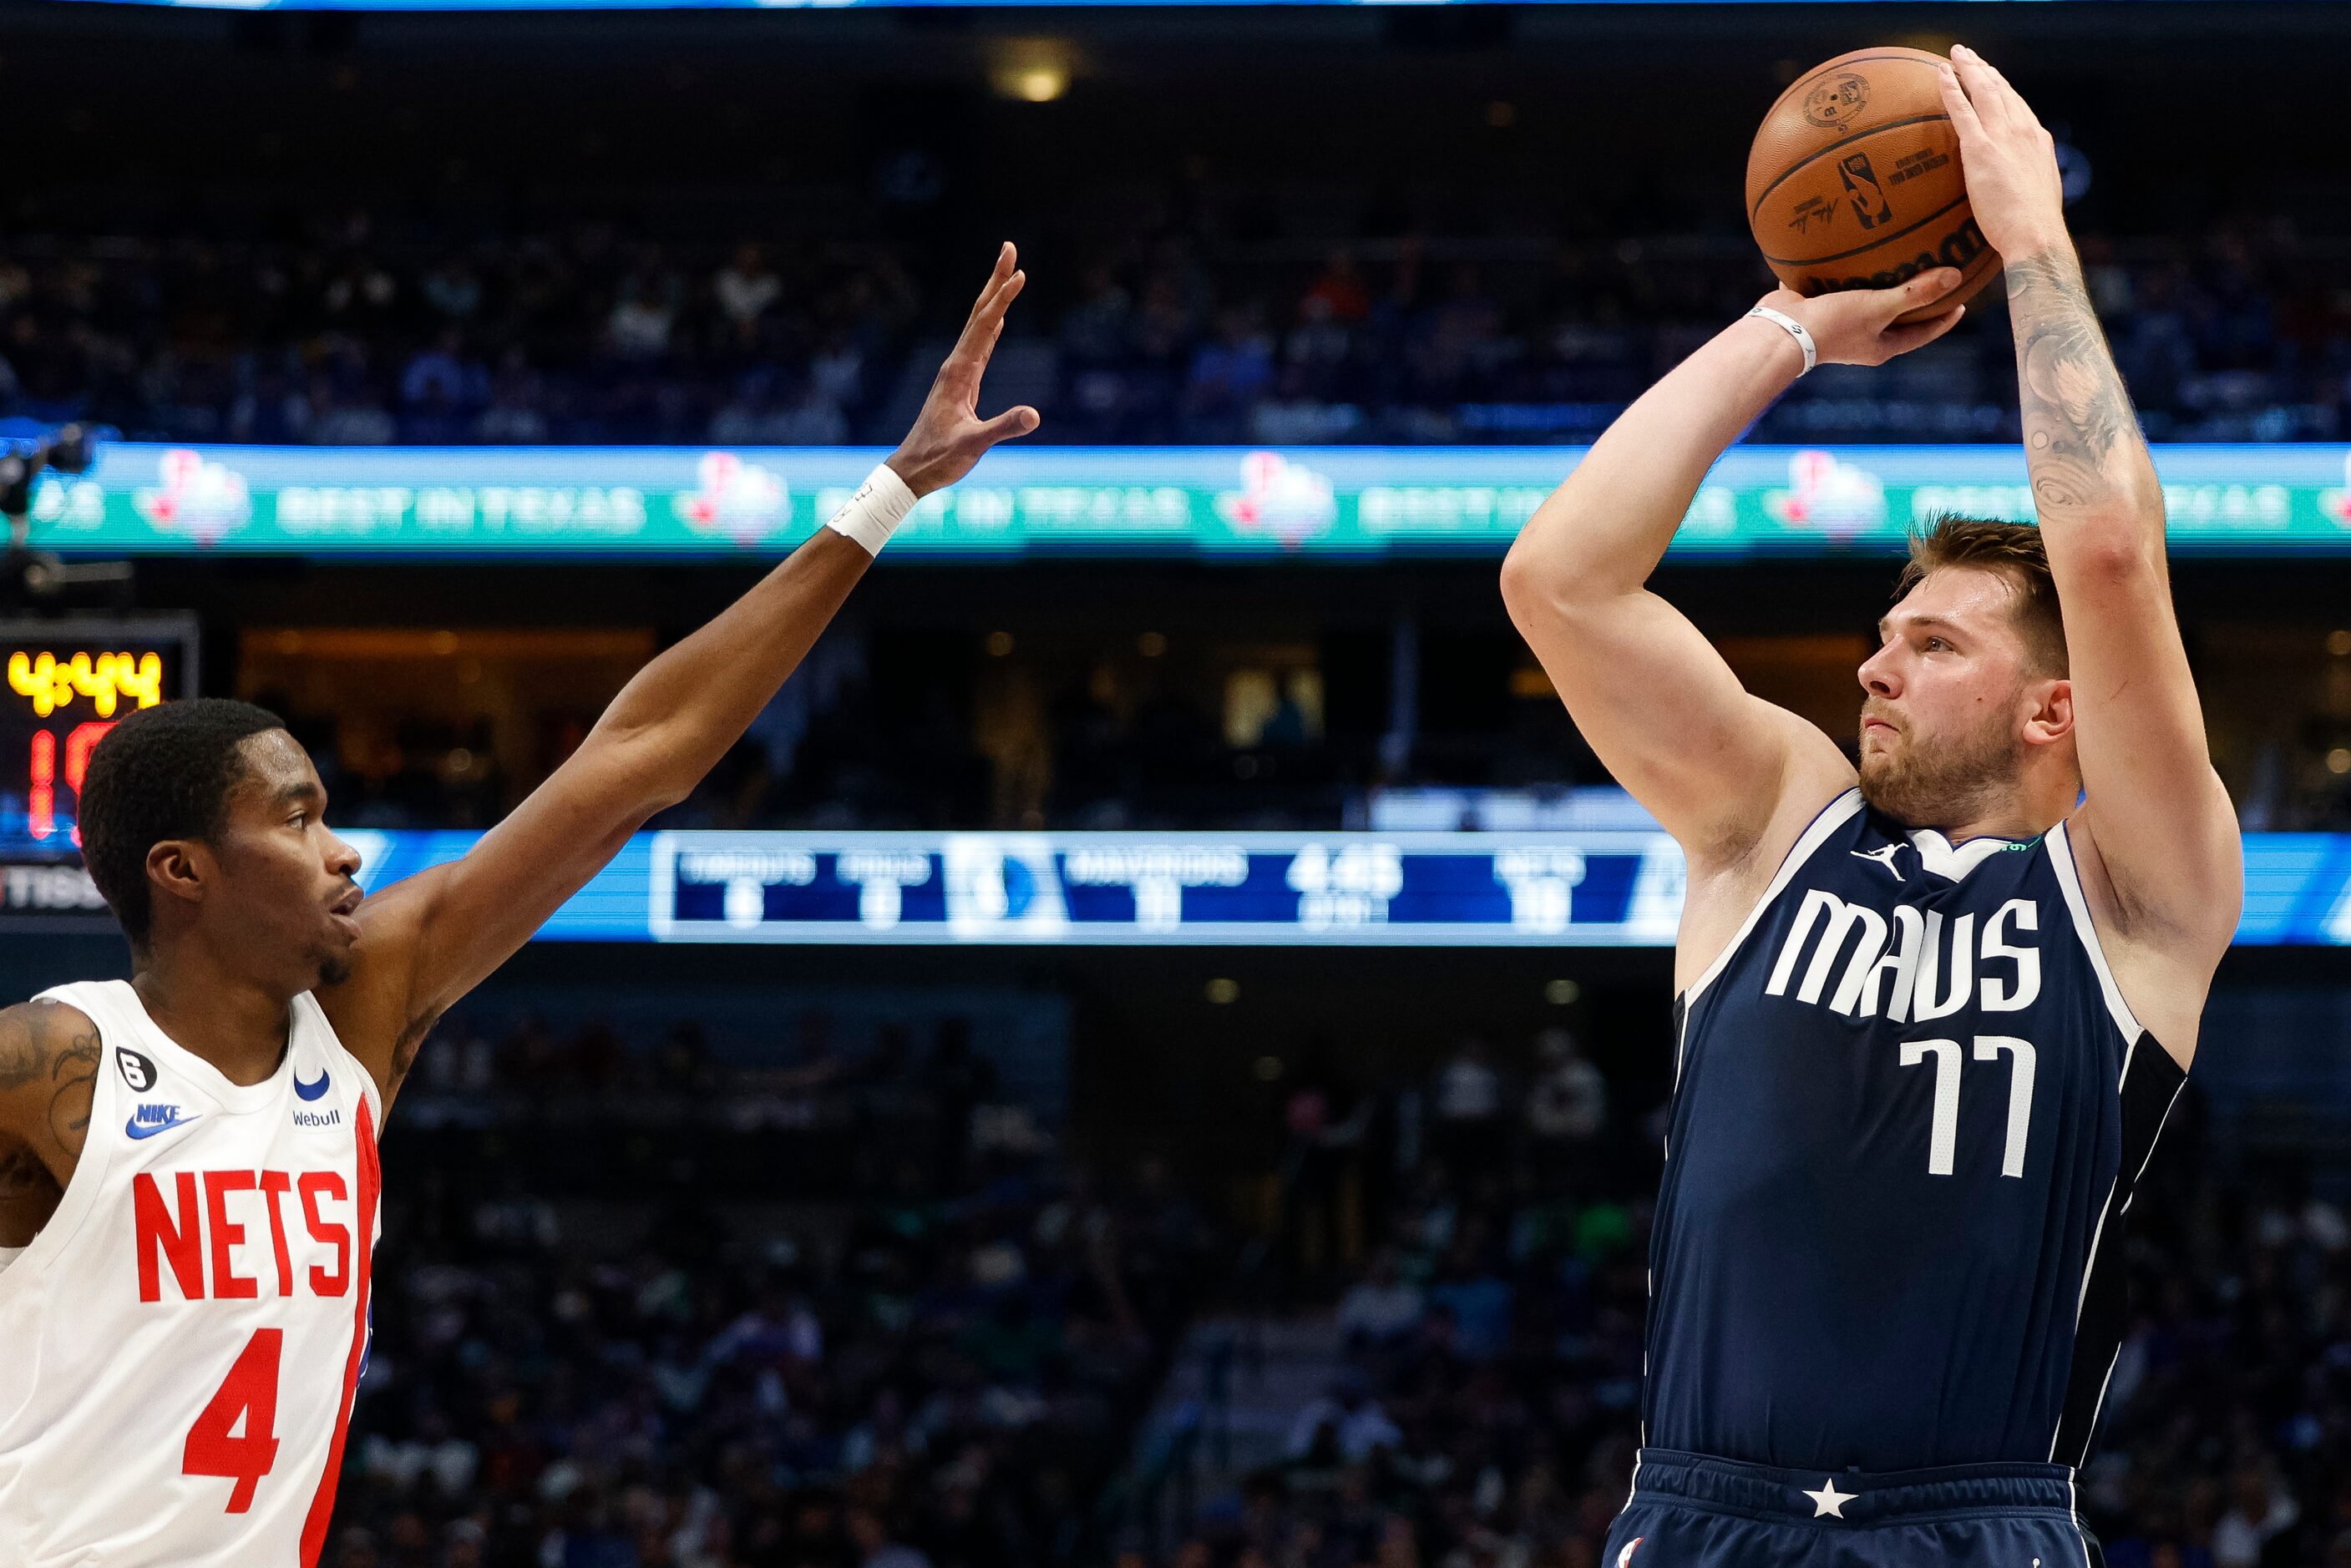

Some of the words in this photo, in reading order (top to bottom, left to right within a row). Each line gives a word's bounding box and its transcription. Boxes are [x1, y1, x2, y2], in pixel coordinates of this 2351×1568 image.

[8, 651, 161, 717] 4:44
[1765, 888, 2042, 1024] MAVS
[119, 1052, 148, 1090] 6
[136, 1104, 180, 1124] NIKE
[292, 1110, 341, 1126] Webull
[1900, 1035, 2036, 1178] 77
[133, 1170, 351, 1302] NETS
[182, 1328, 283, 1514] 4
